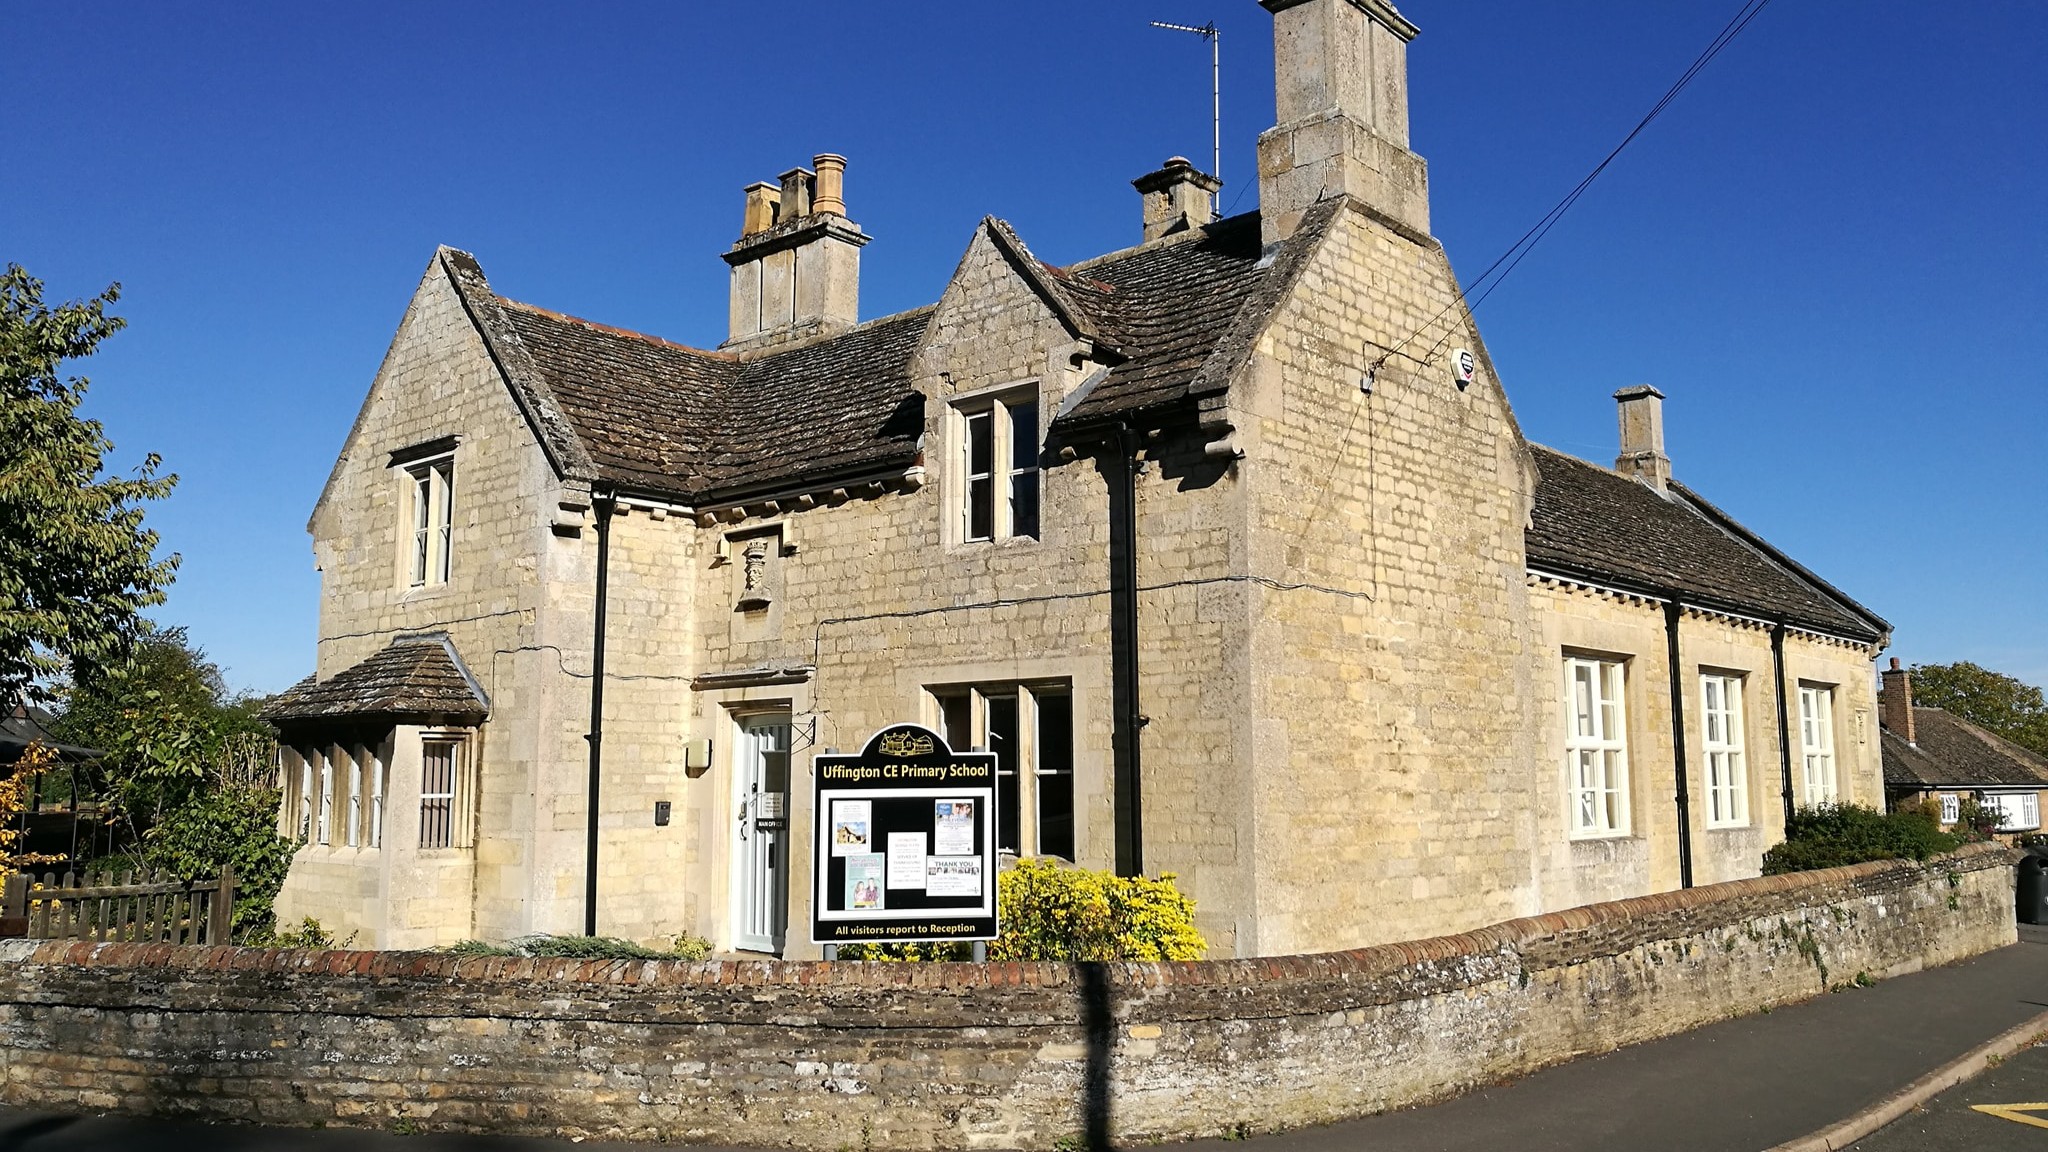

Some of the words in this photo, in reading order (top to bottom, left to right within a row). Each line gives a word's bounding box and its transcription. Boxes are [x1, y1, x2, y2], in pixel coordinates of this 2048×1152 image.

[823, 765, 880, 781] Uffington
[883, 765, 898, 778] CE
[901, 764, 947, 780] Primary
[950, 763, 988, 777] School
[835, 926, 849, 935] All
[850, 925, 884, 935] visitors
[886, 925, 916, 936] report
[917, 924, 928, 933] to
[930, 923, 976, 934] Reception
